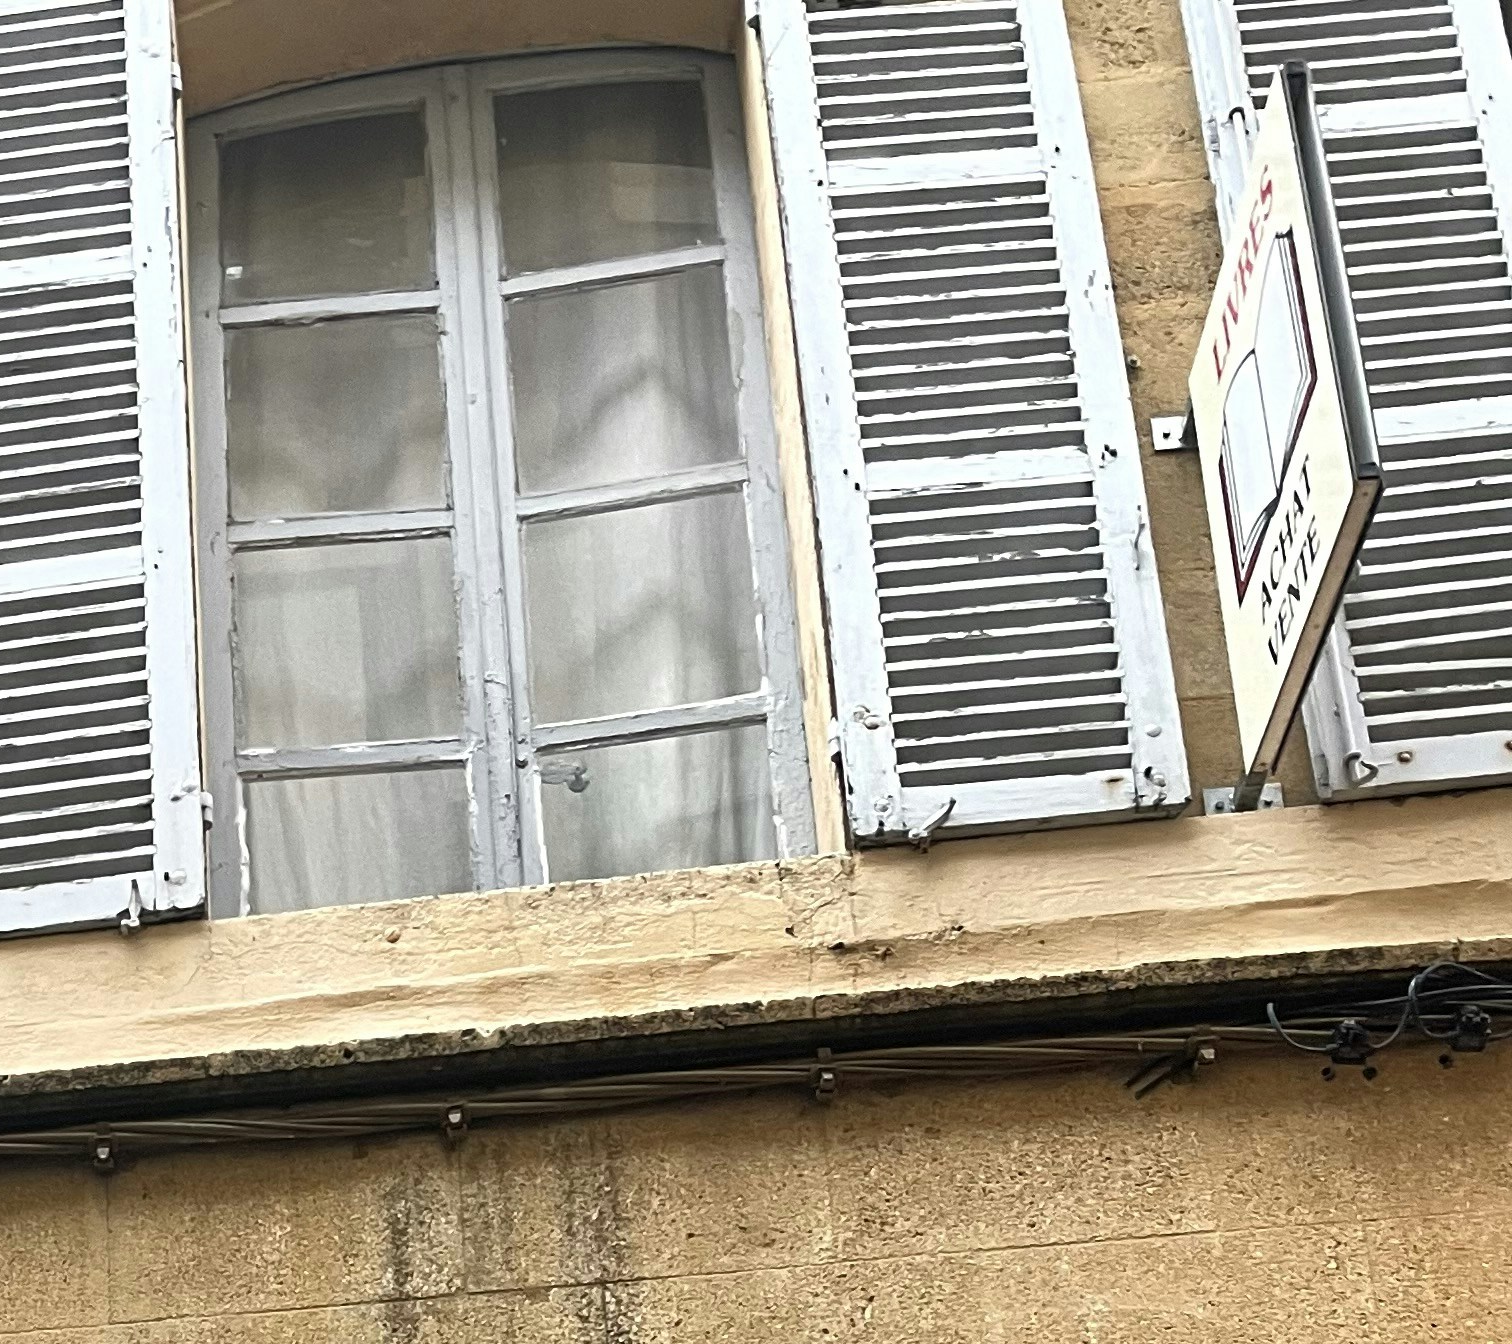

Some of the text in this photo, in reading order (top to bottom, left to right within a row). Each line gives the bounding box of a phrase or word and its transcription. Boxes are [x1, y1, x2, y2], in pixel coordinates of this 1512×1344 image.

[1213, 163, 1273, 385] LIVRES
[1262, 453, 1314, 626] ACHAT
[1266, 515, 1321, 667] VENTE
